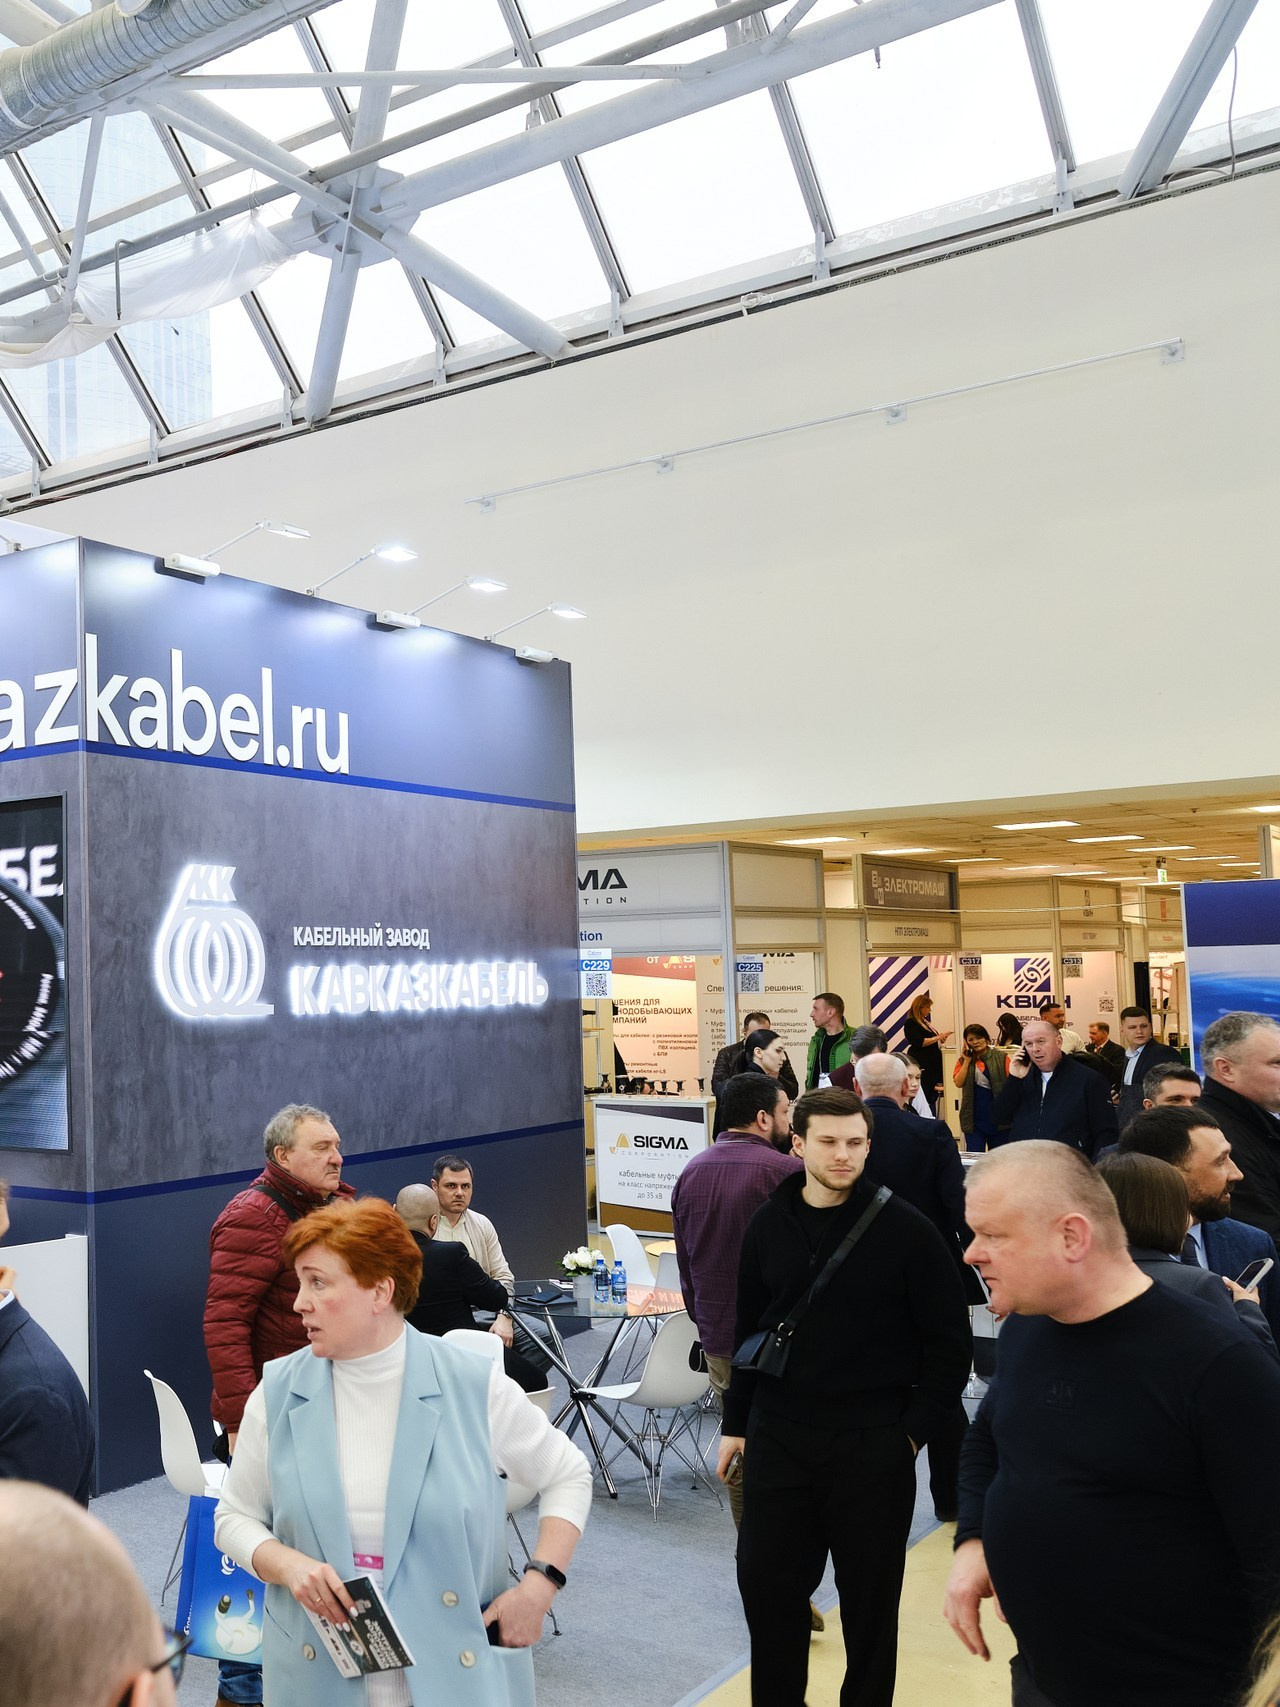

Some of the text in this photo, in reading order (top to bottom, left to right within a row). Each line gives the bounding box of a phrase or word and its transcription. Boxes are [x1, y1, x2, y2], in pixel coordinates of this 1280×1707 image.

[884, 877, 945, 896] ЭЛЕКТРОМАШ
[293, 922, 431, 950] КАБЕЛЬНЫЙ ЗАВОД
[582, 960, 610, 970] C229
[646, 956, 660, 964] ОТ
[738, 963, 762, 972] C225
[292, 961, 550, 1016] КАВКАЗКАБЕЛЬ
[764, 985, 804, 993] решения:
[643, 998, 660, 1007] ДЛЯ
[633, 1135, 689, 1150] SIGMA
[618, 1169, 655, 1179] кабельные
[646, 1191, 654, 1199] 35
